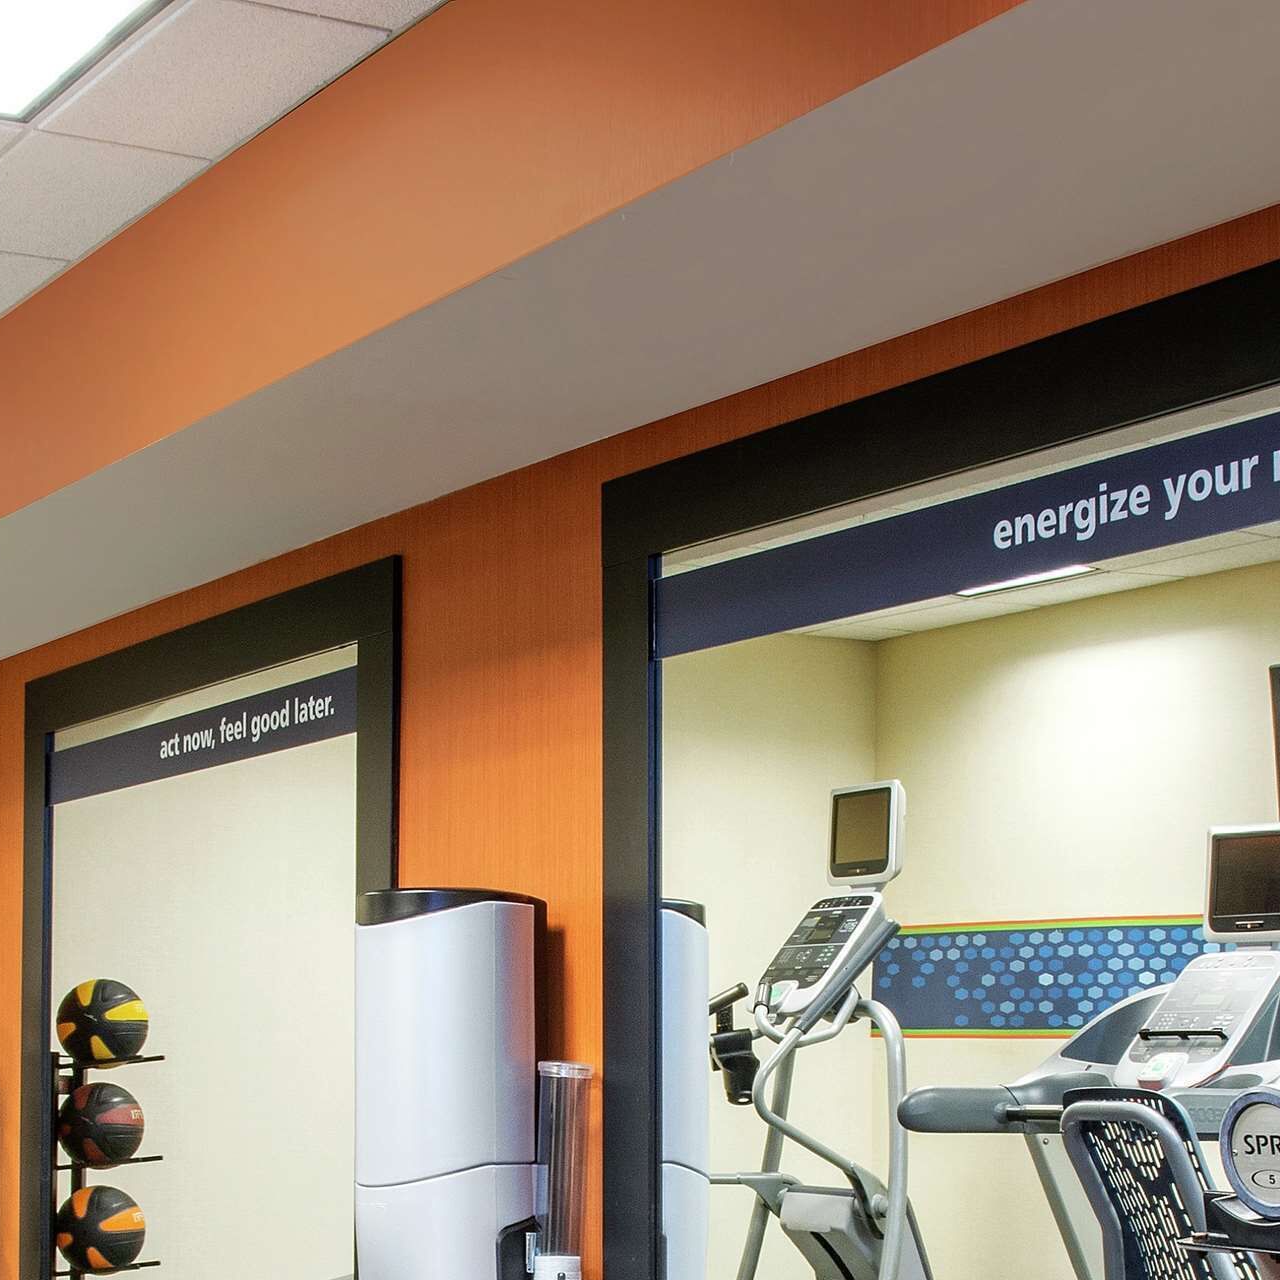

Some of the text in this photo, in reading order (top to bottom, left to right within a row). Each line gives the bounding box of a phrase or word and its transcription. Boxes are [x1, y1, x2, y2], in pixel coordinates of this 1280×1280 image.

[992, 483, 1151, 549] energize
[1163, 455, 1259, 519] your
[160, 695, 335, 759] act now, feel good later.
[1268, 1174, 1276, 1185] 5
